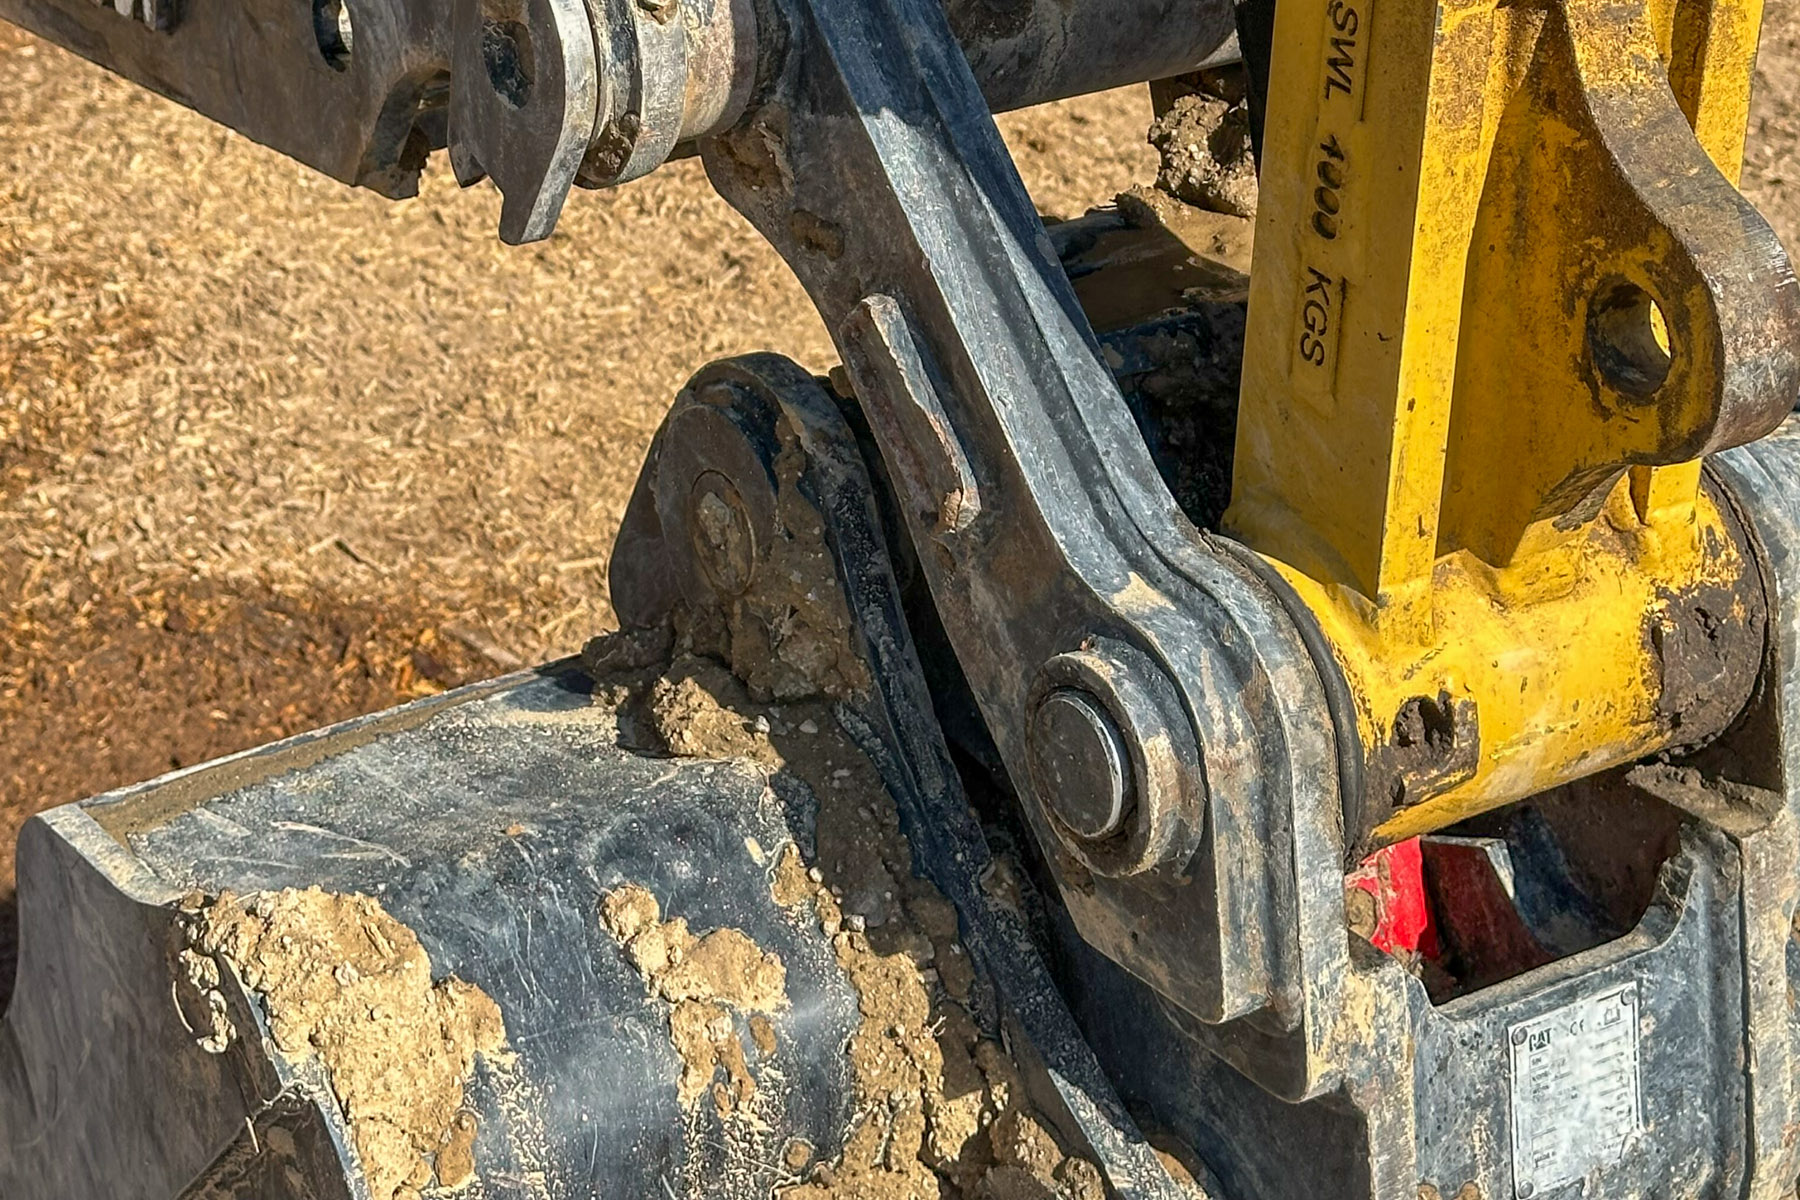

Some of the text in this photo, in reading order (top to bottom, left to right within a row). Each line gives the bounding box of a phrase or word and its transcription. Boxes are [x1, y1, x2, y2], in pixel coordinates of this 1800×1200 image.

[1325, 0, 1359, 100] SWL
[1301, 266, 1332, 367] KGS
[1529, 1027, 1552, 1052] CAT
